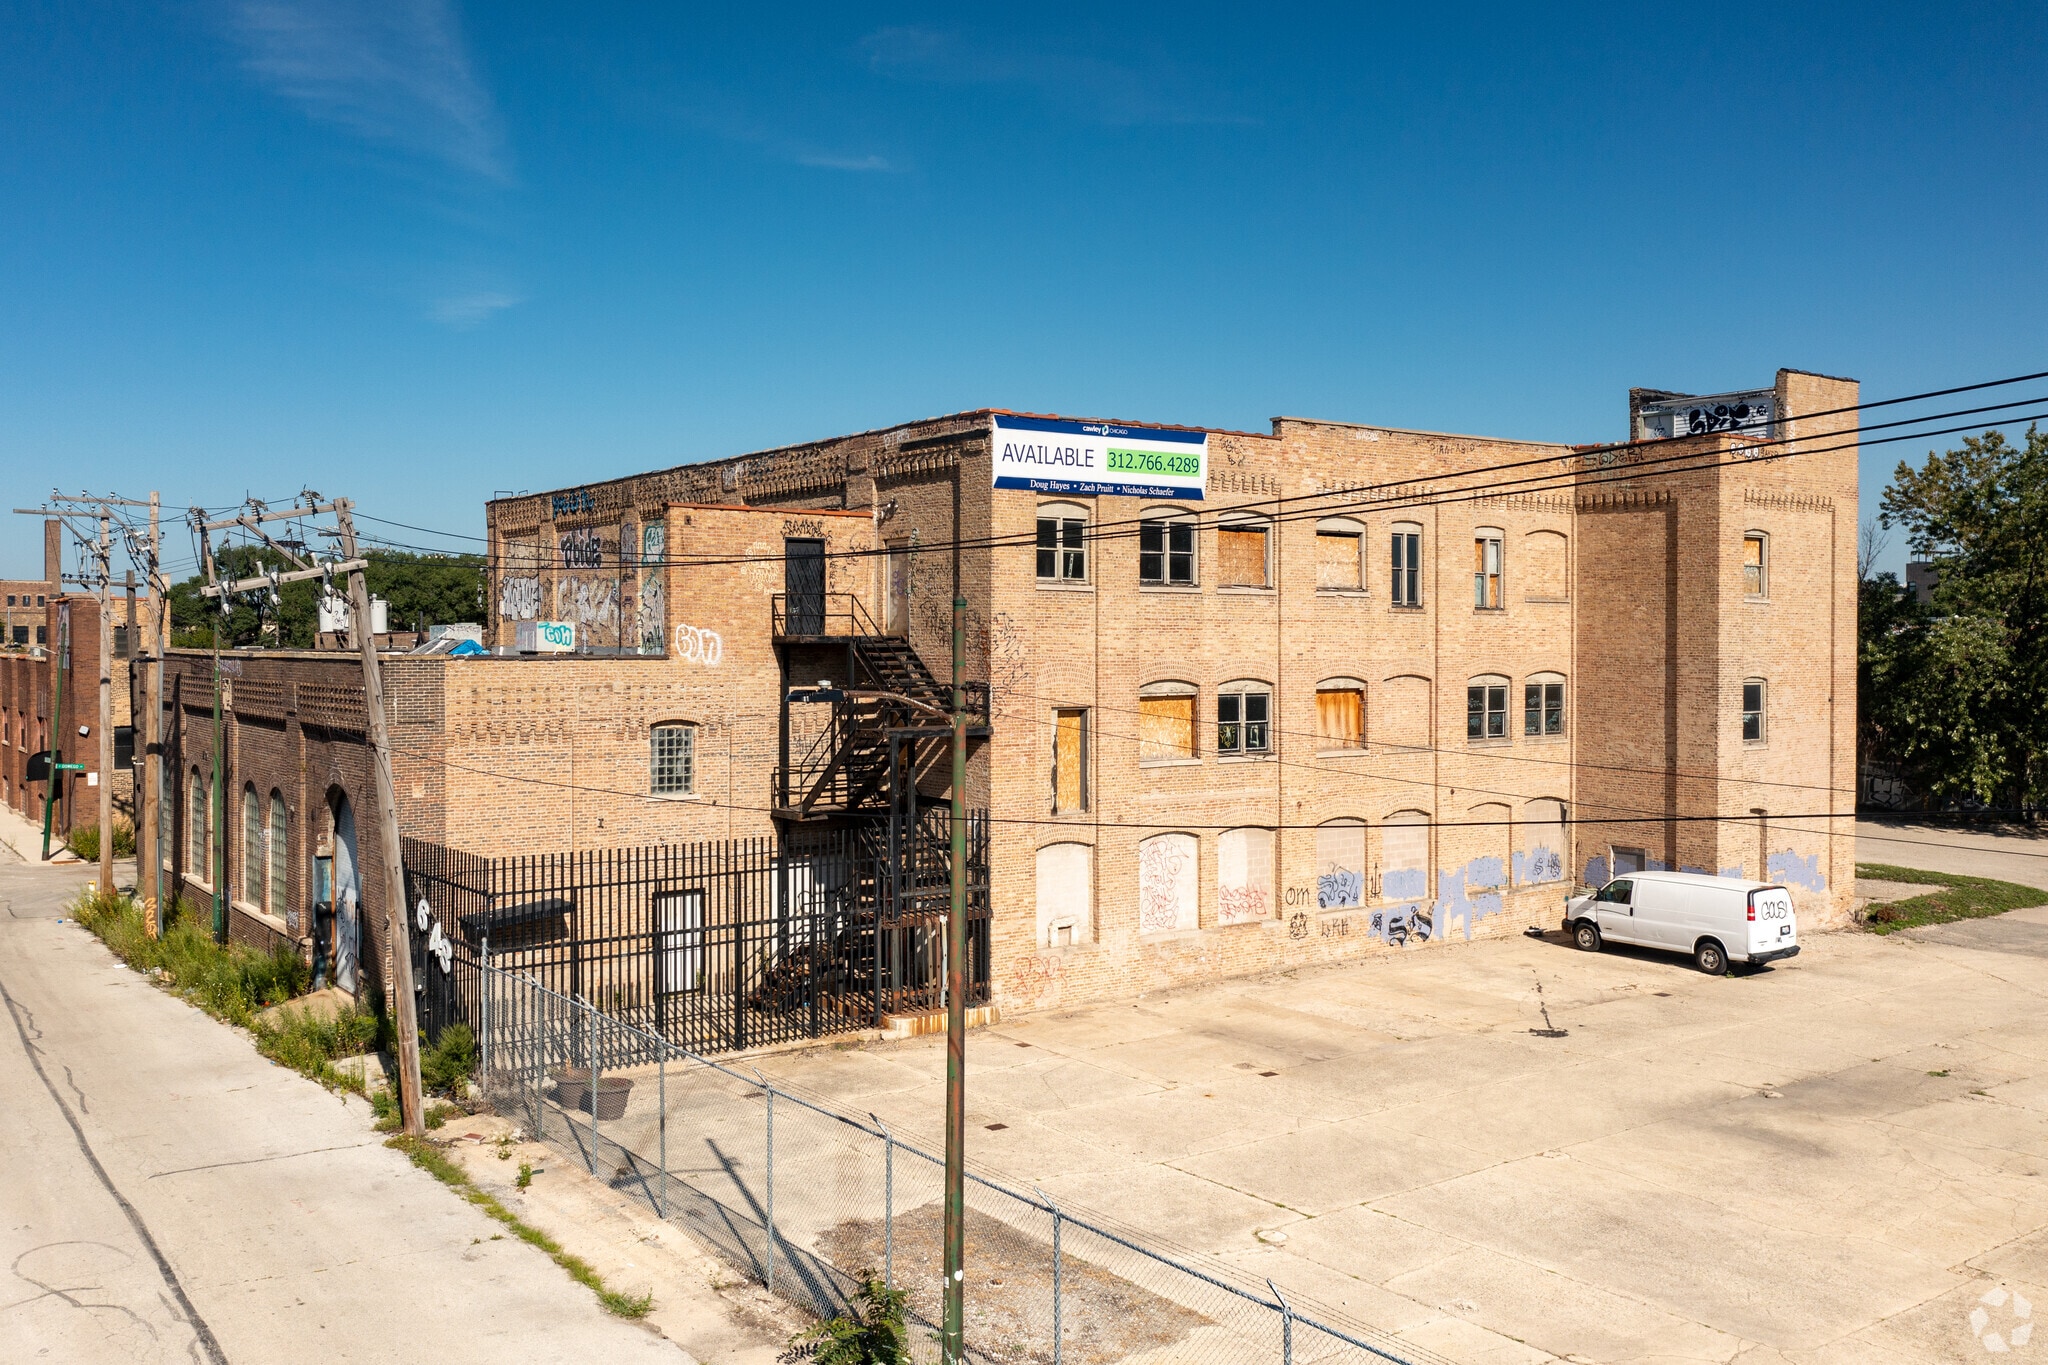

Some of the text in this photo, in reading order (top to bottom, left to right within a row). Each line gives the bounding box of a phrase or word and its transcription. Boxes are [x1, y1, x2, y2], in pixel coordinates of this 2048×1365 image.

[1082, 425, 1101, 434] cawley
[1002, 443, 1094, 467] AVAILABLE
[1108, 452, 1199, 473] 312.766.4289
[1030, 480, 1175, 496] Doug Hayes Zach Pruitt Nicholas Schaefer
